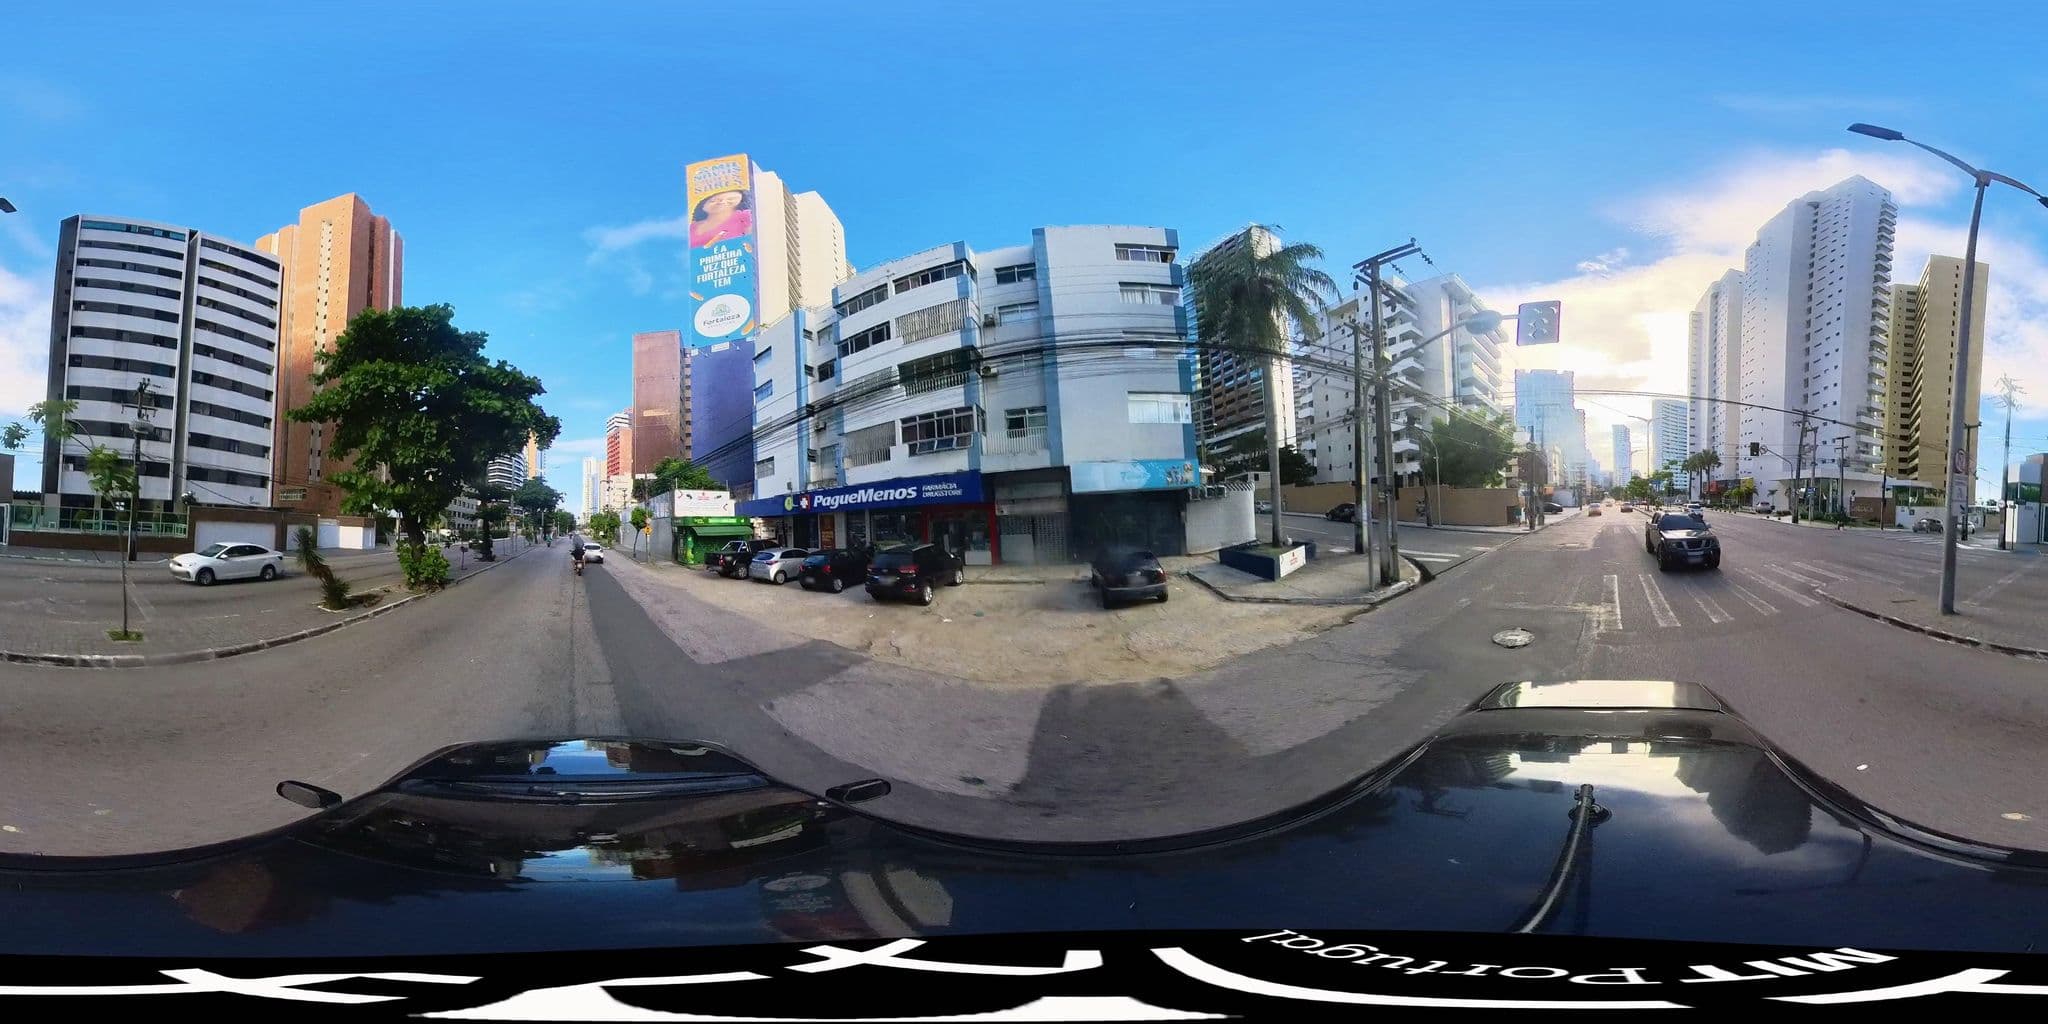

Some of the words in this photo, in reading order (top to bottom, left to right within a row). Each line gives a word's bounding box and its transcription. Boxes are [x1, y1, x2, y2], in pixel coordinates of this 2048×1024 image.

[720, 244, 727, 252] A
[699, 249, 742, 265] PRIMEIRA
[703, 262, 719, 272] VEZ
[720, 257, 738, 268] QUE
[696, 264, 746, 284] FORTALEZA
[713, 276, 731, 288] TEM
[703, 313, 741, 326] Fortaleza
[813, 487, 917, 509] PagueMenos
